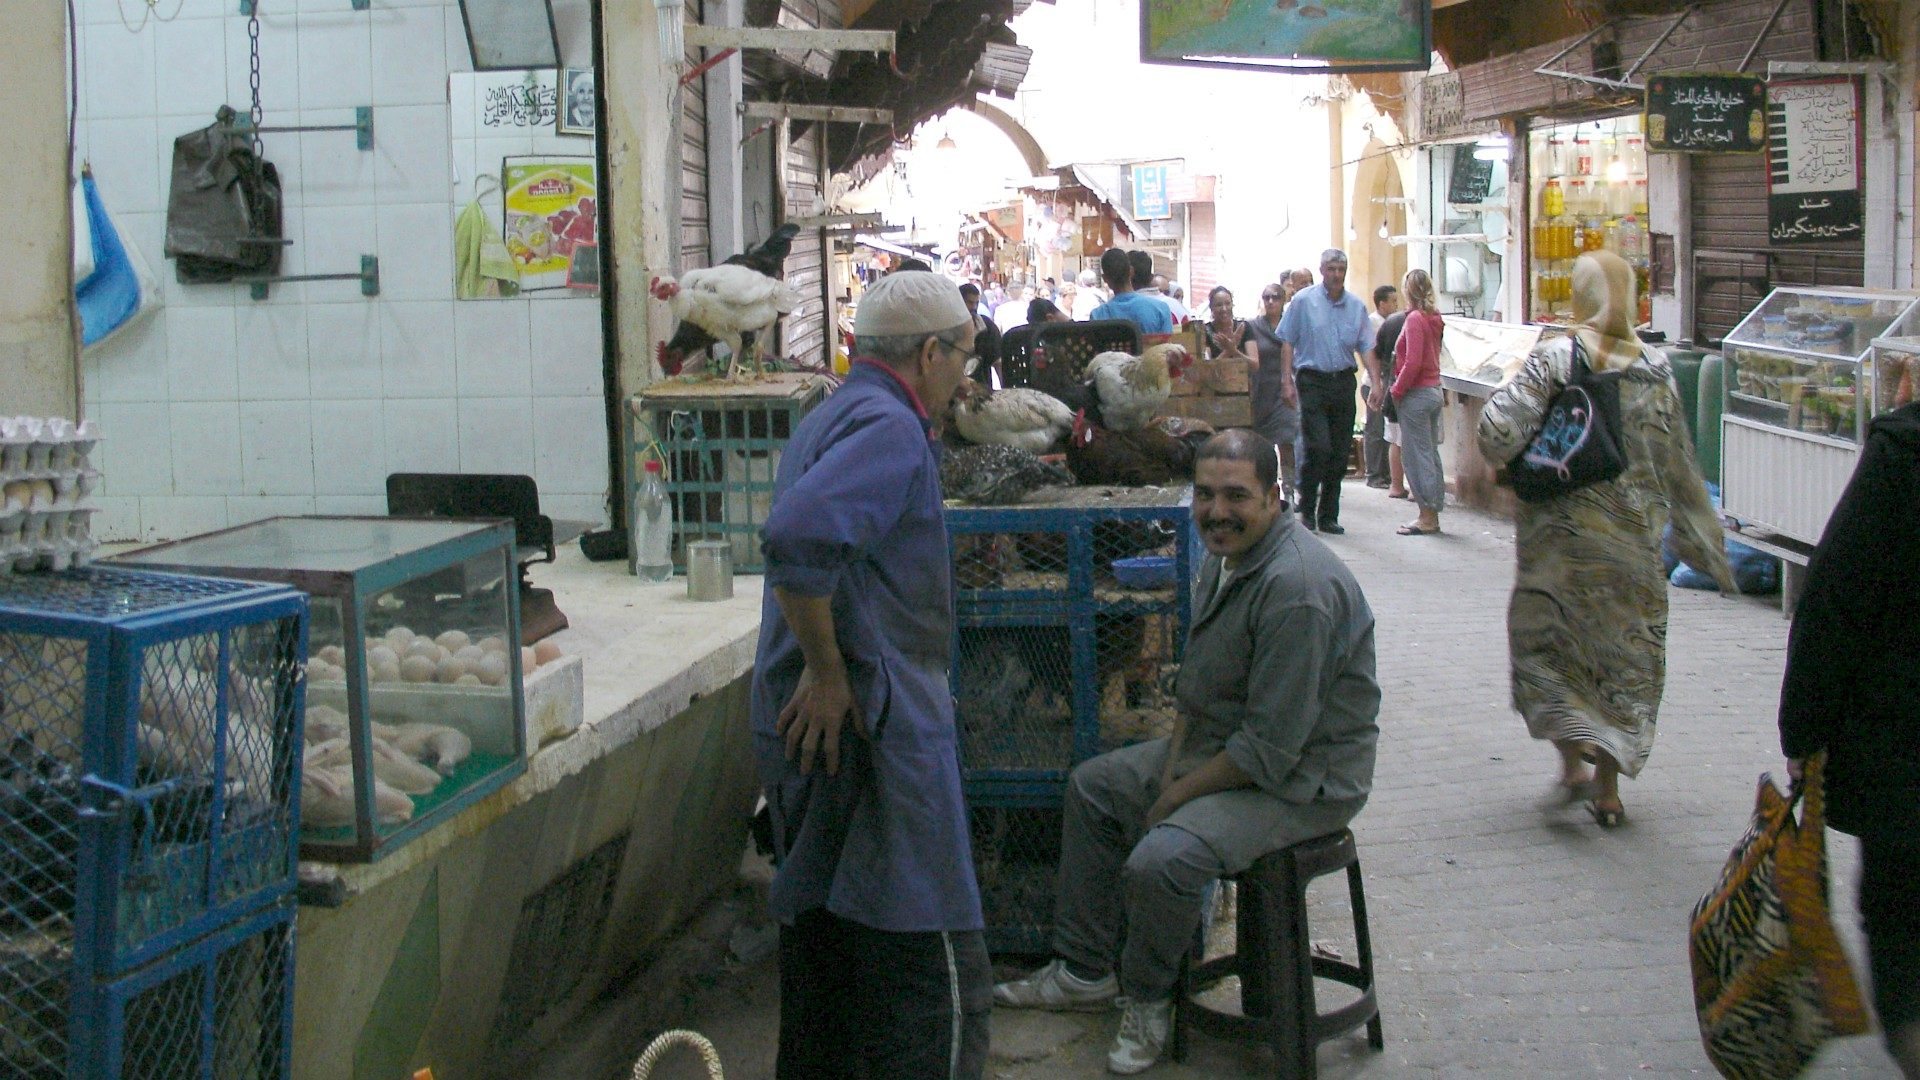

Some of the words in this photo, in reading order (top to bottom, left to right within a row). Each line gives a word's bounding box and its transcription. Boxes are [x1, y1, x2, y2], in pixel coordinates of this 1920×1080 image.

[1692, 111, 1725, 123] عند
[1706, 129, 1734, 147] الحاج
[1799, 197, 1832, 210] عند
[1823, 222, 1861, 238] حسين
